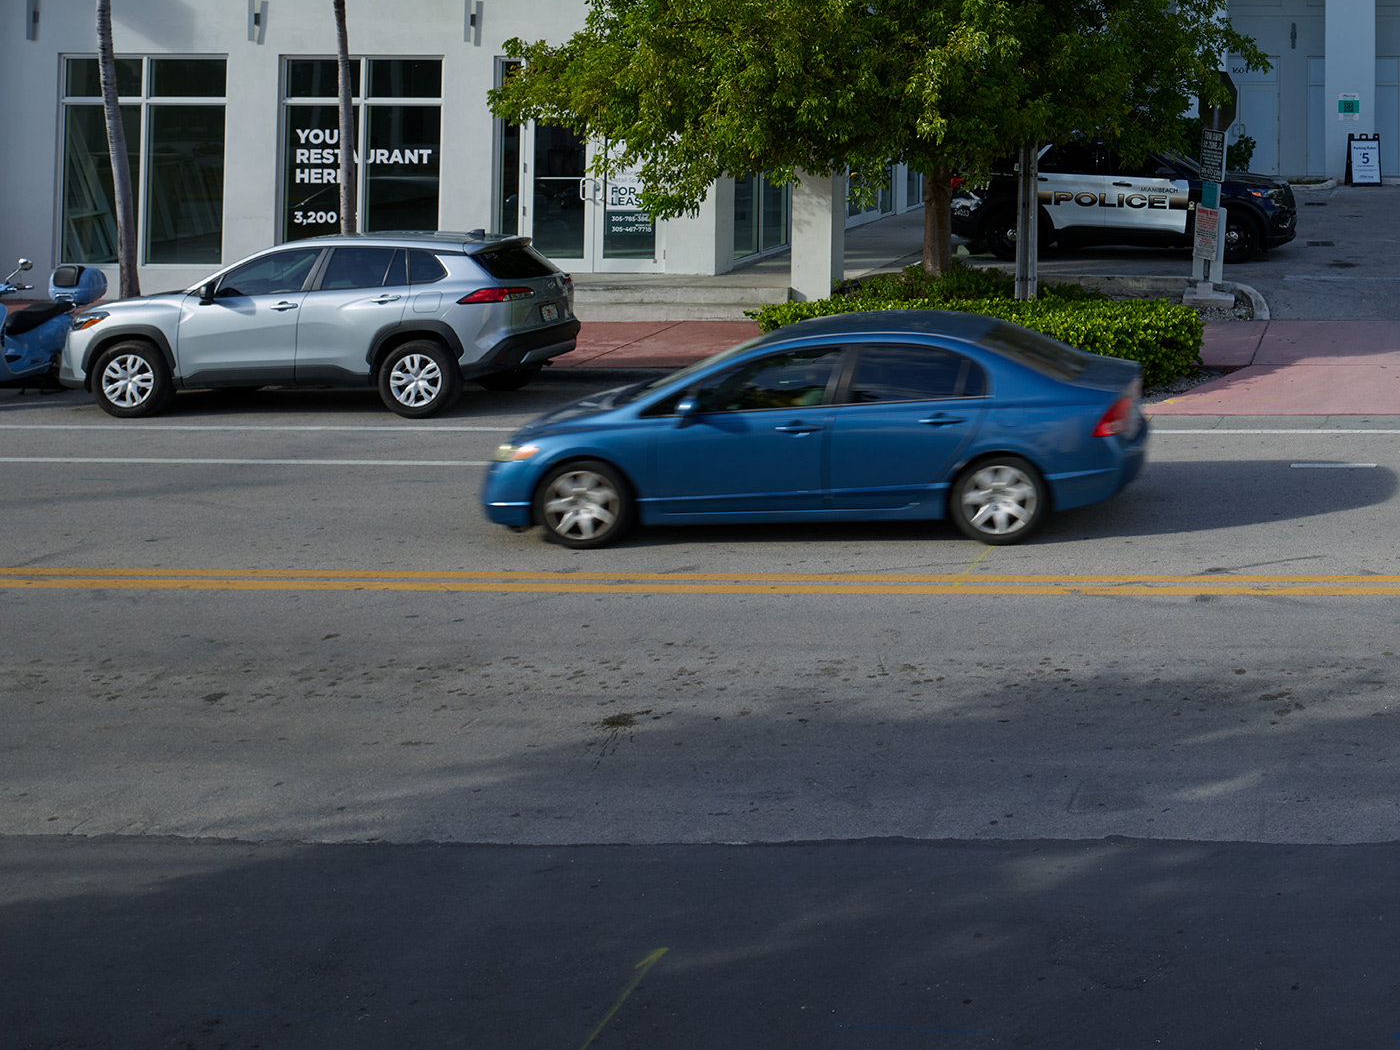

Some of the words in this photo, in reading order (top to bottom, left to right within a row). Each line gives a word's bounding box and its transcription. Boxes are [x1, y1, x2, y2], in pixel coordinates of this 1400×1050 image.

[296, 129, 339, 145] YOU
[611, 187, 637, 196] FOR
[611, 197, 642, 206] LEAS
[1053, 191, 1168, 210] POLICE
[293, 211, 337, 225] 3,200
[953, 208, 970, 218] 24053
